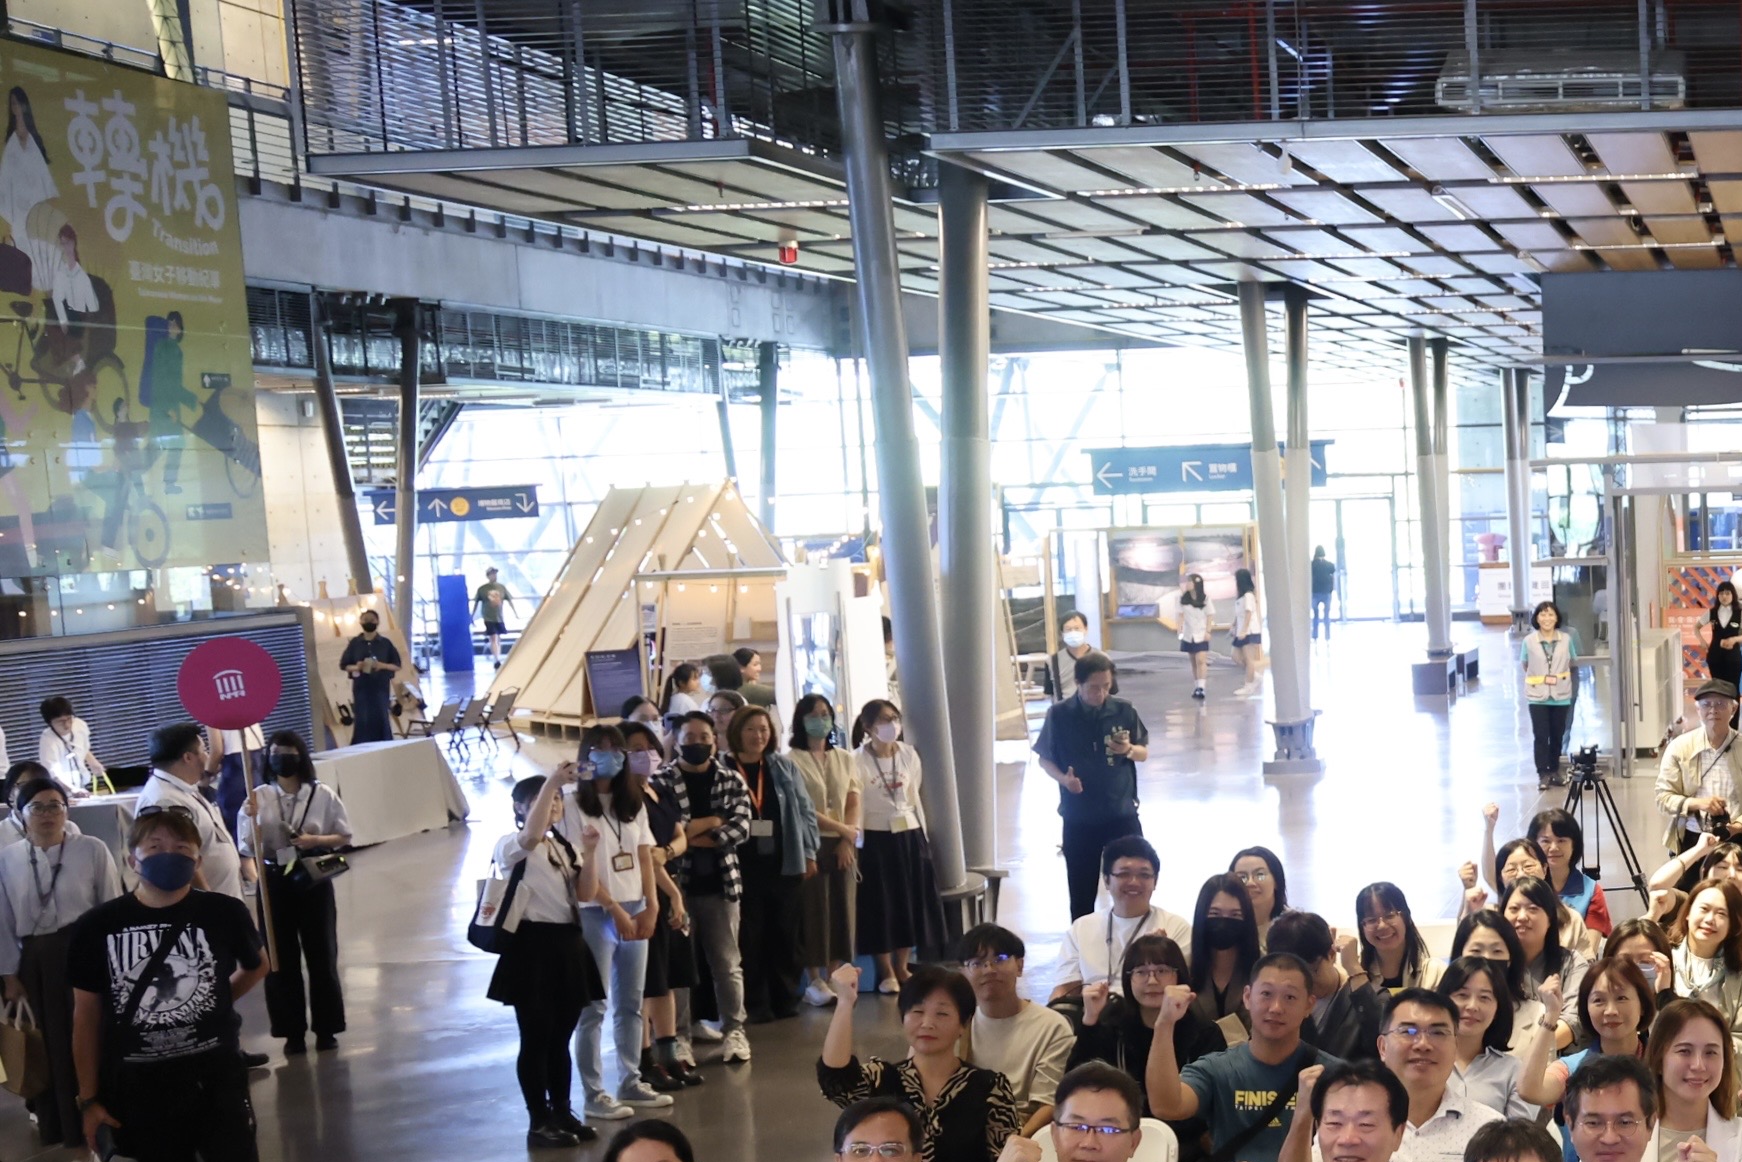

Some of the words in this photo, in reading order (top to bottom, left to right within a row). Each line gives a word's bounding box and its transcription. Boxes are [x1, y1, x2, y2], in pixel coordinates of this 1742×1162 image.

[63, 89, 225, 243] 轉機
[152, 217, 219, 256] Transition
[106, 927, 214, 980] NIRVNA
[120, 982, 210, 1024] NVERMIND
